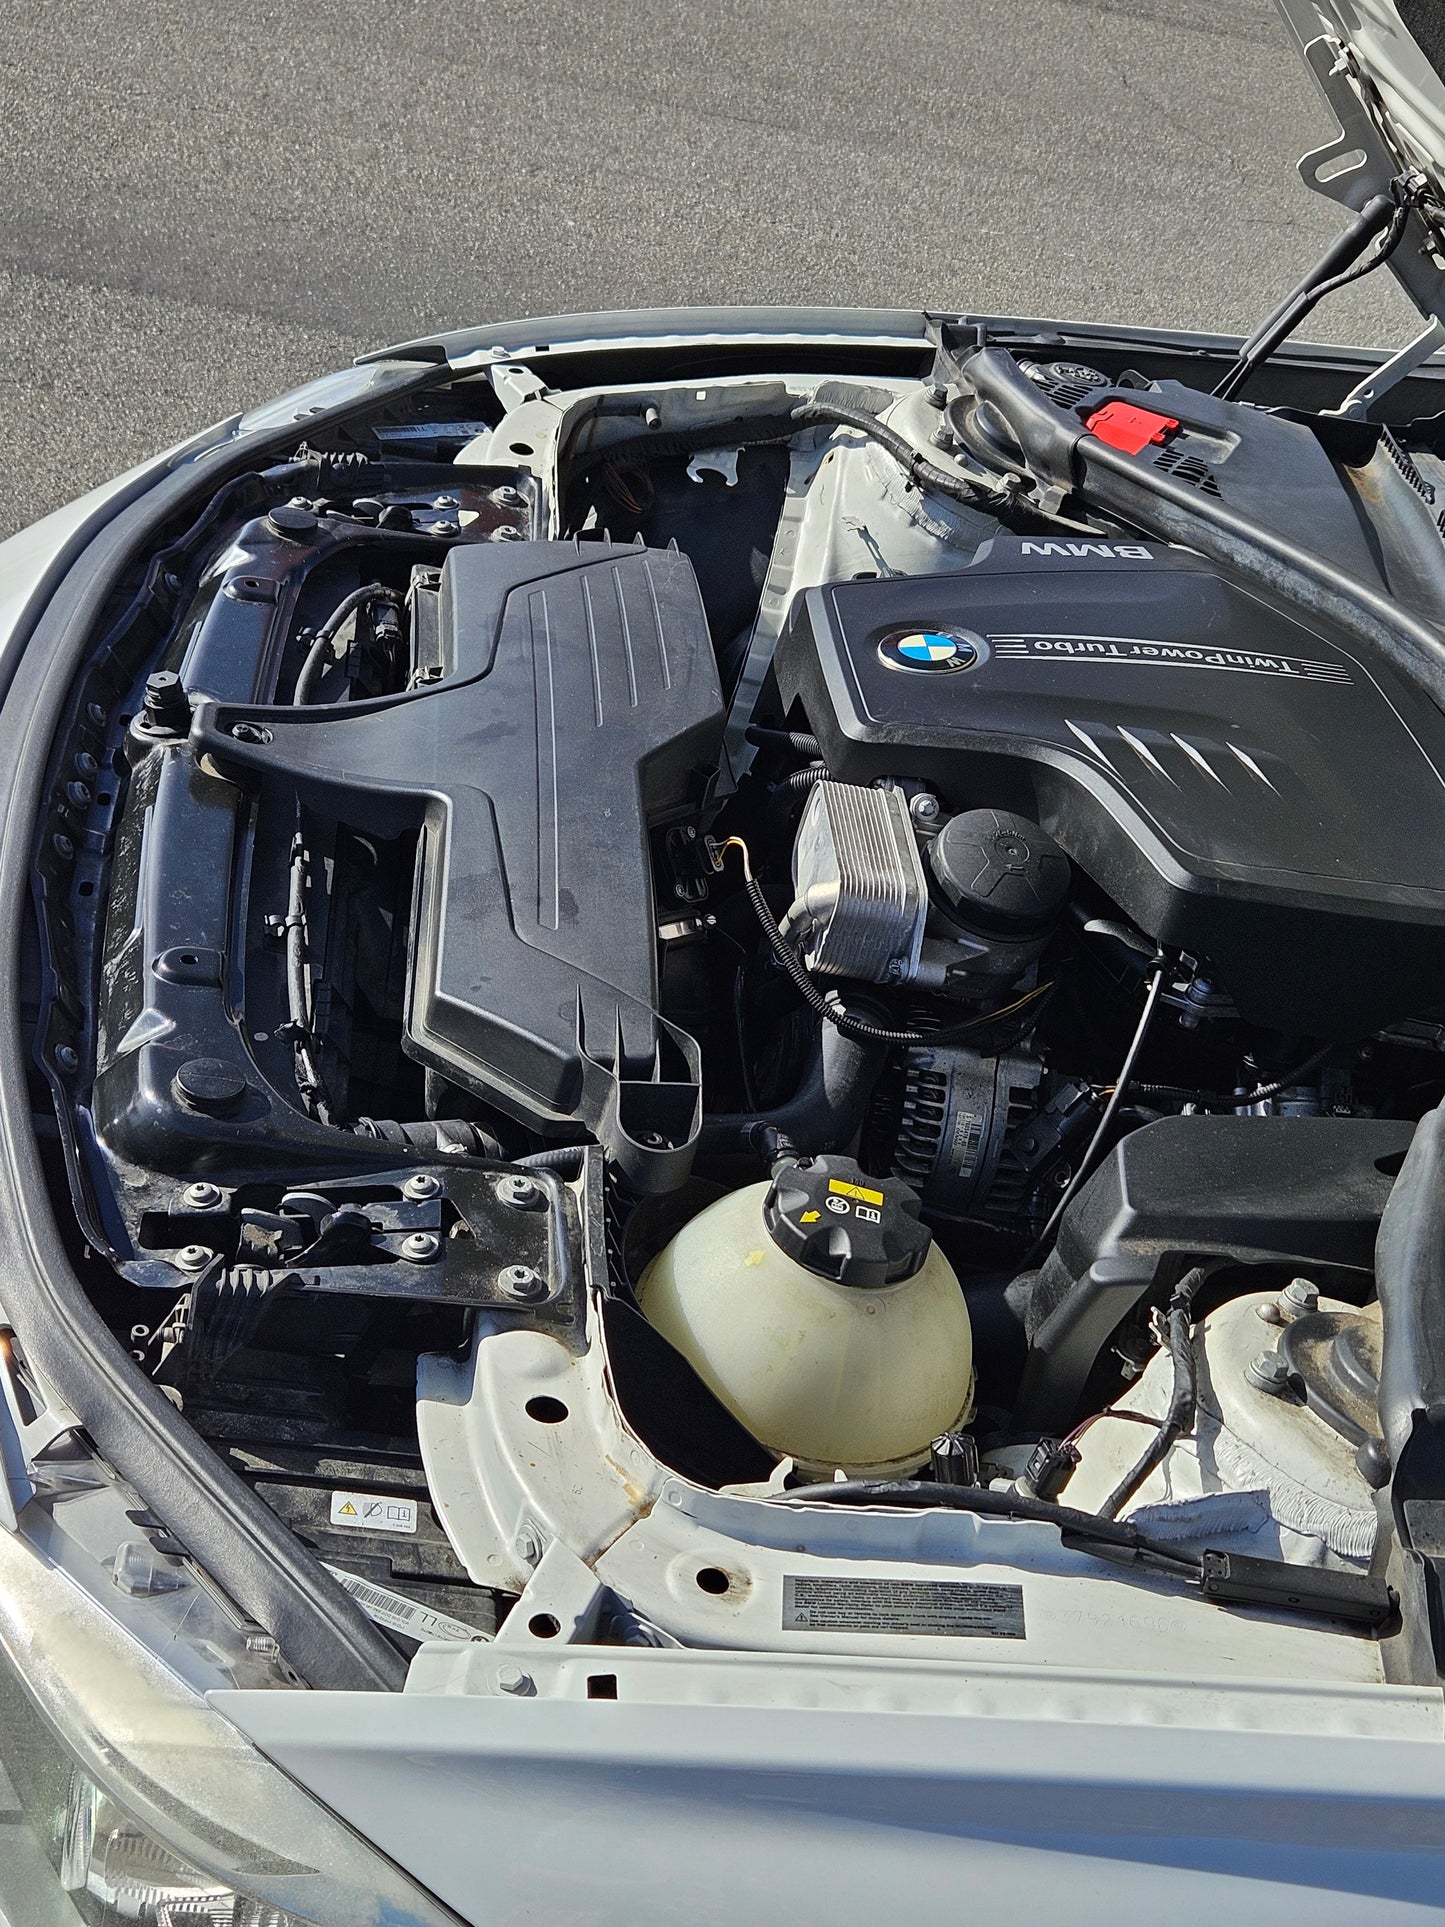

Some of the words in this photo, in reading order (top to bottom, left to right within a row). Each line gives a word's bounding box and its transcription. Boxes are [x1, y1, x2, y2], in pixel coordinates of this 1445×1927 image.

[1022, 541, 1154, 560] BMW
[1034, 640, 1128, 656] Turbo
[1130, 645, 1300, 674] TwinPower
